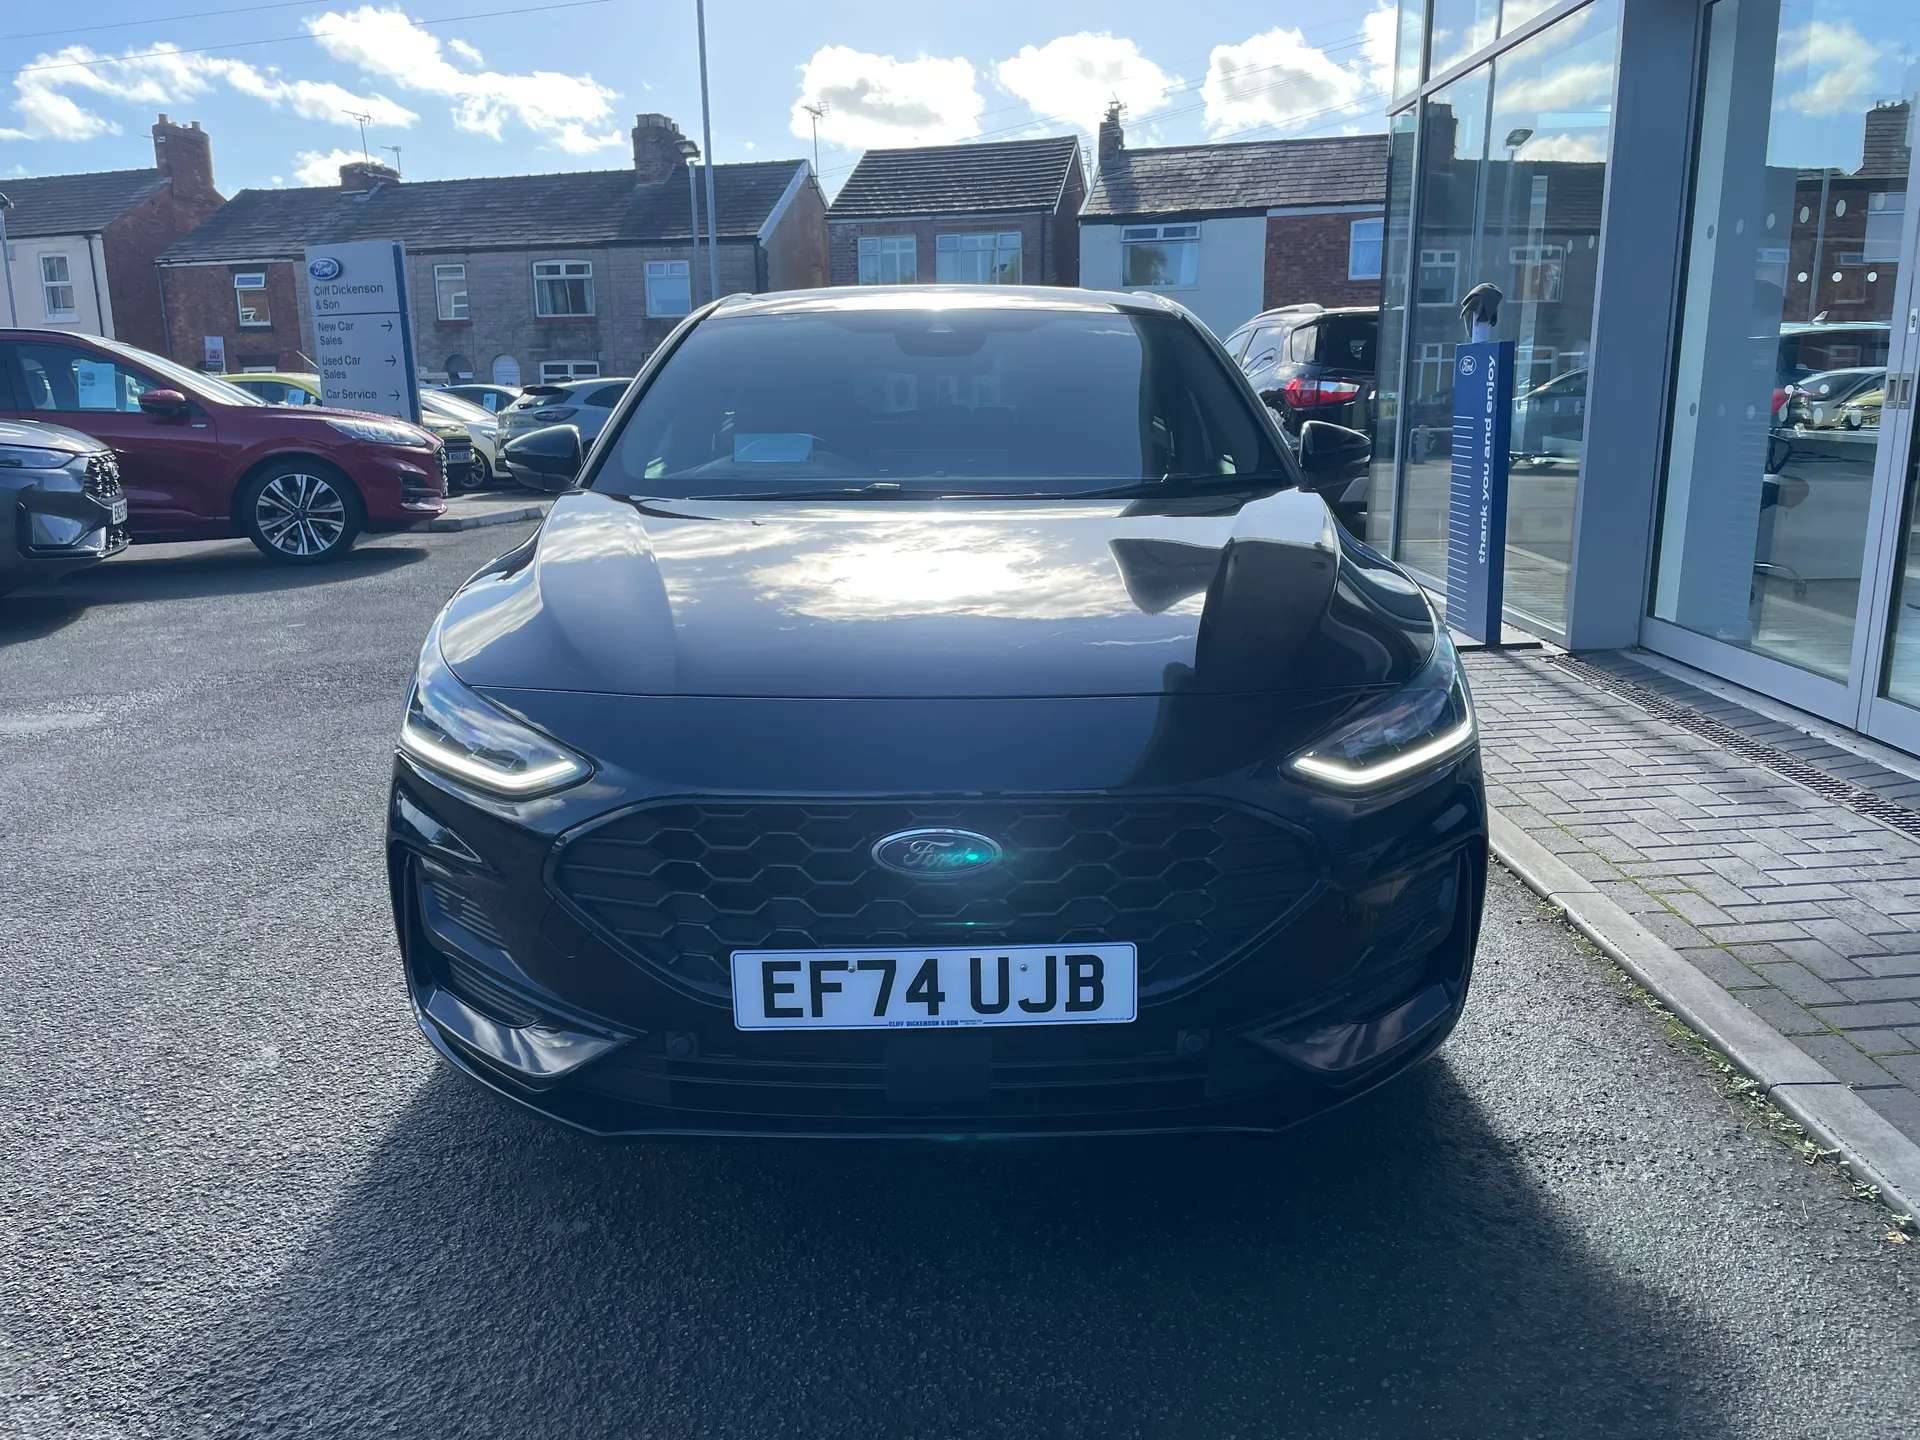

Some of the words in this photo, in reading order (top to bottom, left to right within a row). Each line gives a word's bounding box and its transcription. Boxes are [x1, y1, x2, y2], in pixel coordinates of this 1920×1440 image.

[314, 285, 330, 297] Cliff
[331, 284, 384, 296] Dickenson
[315, 301, 322, 310] &
[323, 299, 340, 310] Son
[318, 322, 336, 333] New
[337, 320, 354, 332] Car
[319, 335, 343, 346] Sales
[321, 355, 342, 366] Used
[344, 355, 361, 366] Car
[323, 369, 347, 380] Sales
[1486, 355, 1496, 414] enjoy
[326, 388, 341, 399] Car
[342, 388, 378, 399] Service
[1484, 417, 1492, 459] and
[1482, 463, 1490, 500] you
[1479, 504, 1488, 564] thank
[903, 839, 973, 867] Ford
[761, 957, 946, 1018] EF74
[969, 953, 1105, 1014] UJB
